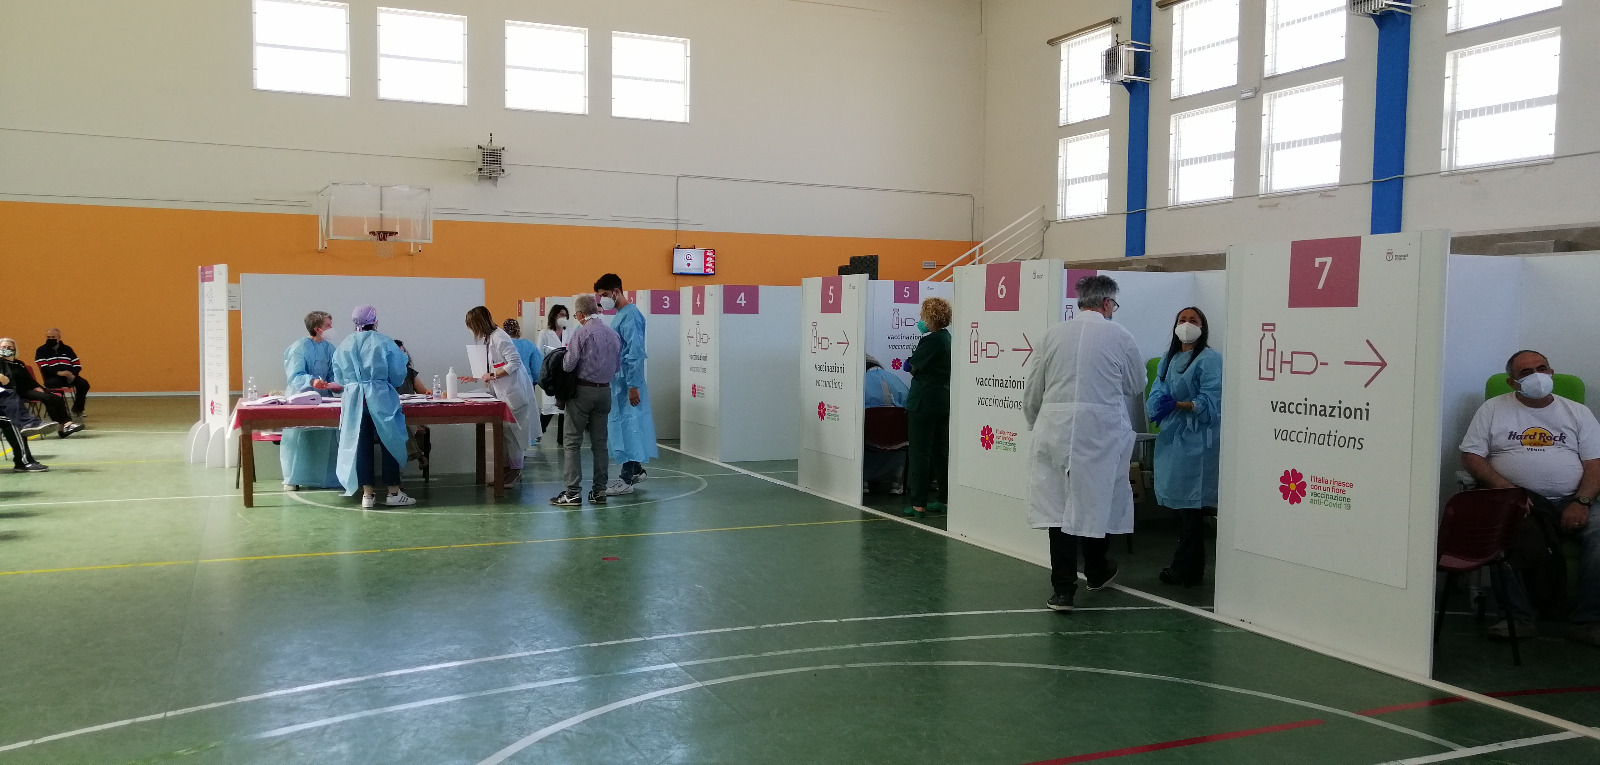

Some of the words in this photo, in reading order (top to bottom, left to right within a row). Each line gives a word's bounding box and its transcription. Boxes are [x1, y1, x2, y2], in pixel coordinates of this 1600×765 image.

[1314, 256, 1333, 290] 7
[828, 285, 835, 304] 5
[903, 286, 910, 298] 5
[997, 275, 1007, 299] 6
[662, 295, 670, 309] 3
[696, 293, 701, 308] 4
[736, 292, 747, 307] 4
[975, 374, 1025, 390] vaccinazioni
[977, 395, 1023, 410] vaccinations
[1270, 397, 1370, 421] vaccinazioni
[1273, 427, 1365, 450] vaccinations
[1507, 431, 1537, 441] Hard
[1538, 432, 1567, 444] Rock
[1330, 479, 1354, 488] rinasce
[1331, 486, 1346, 494] fiore
[1309, 498, 1342, 508] anti-Covid
[1310, 491, 1351, 502] vaccinazione
